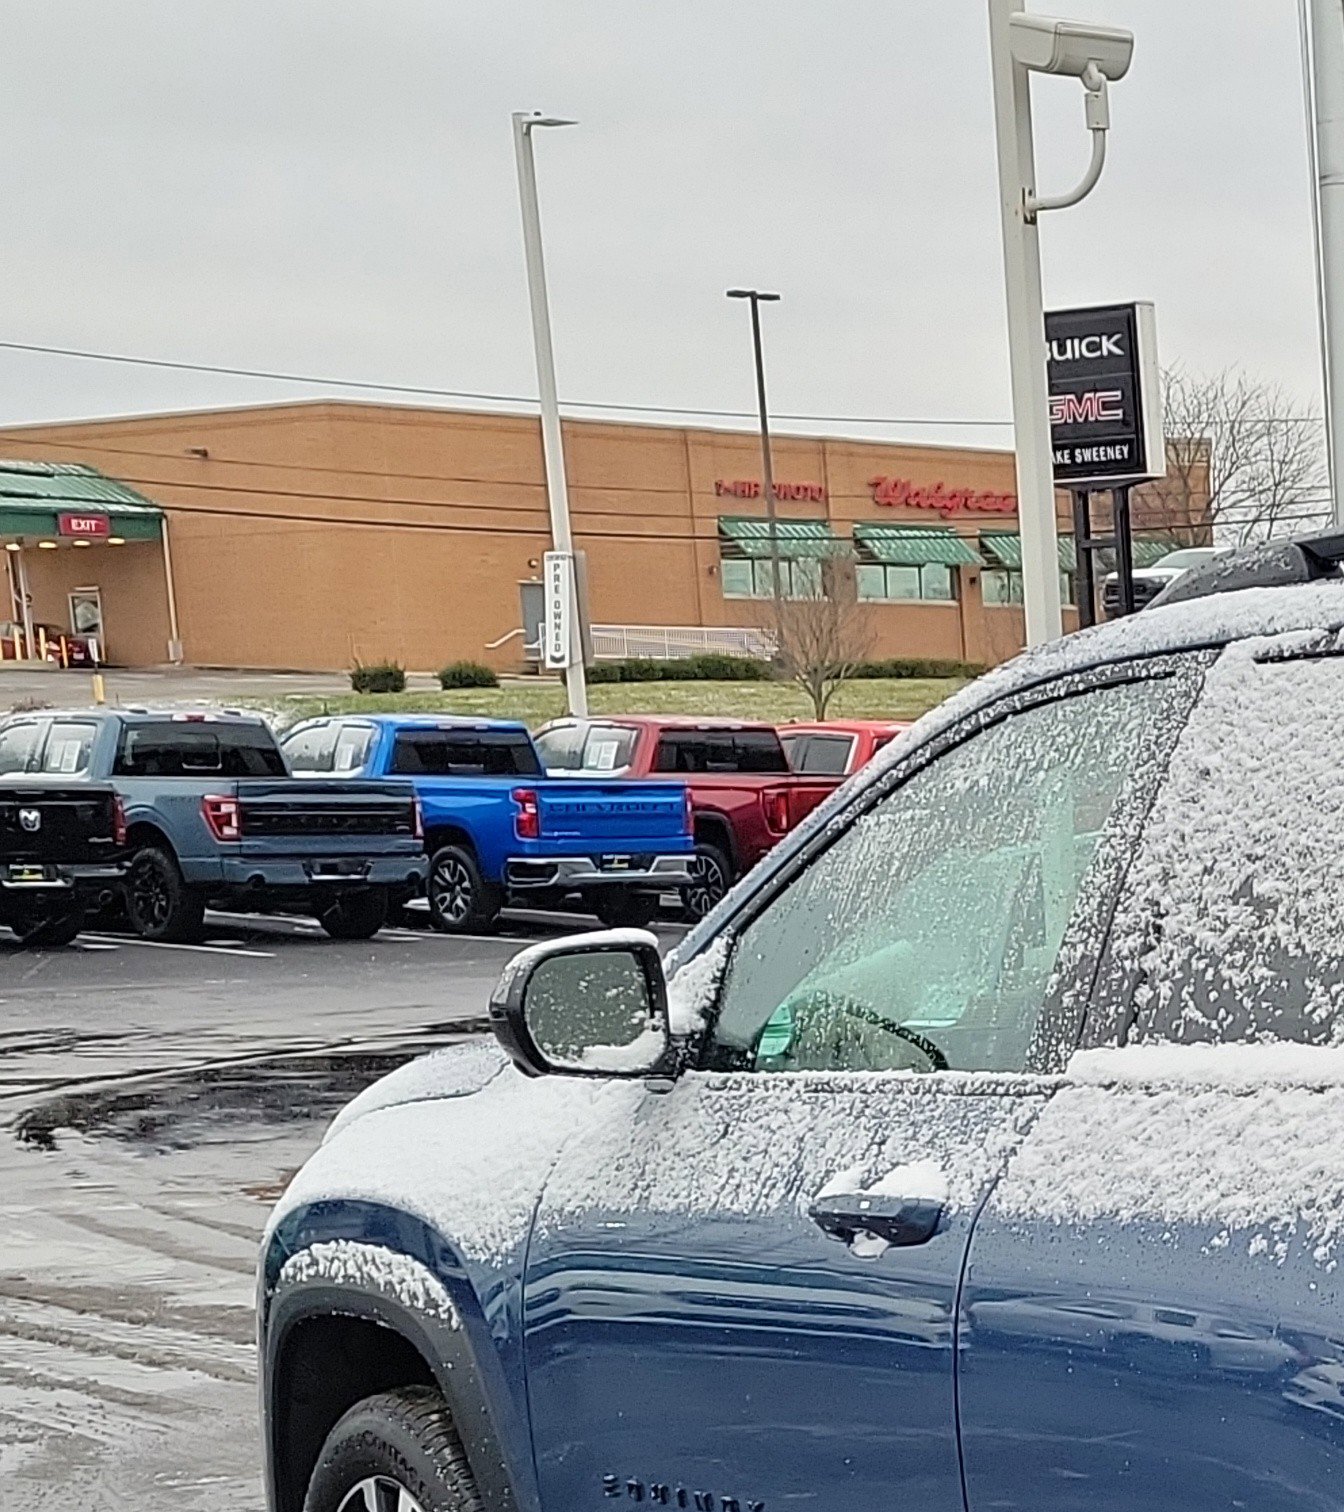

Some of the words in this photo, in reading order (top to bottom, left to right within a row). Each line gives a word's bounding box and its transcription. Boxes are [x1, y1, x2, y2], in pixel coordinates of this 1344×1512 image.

[1048, 390, 1123, 424] GMC
[1051, 448, 1071, 464] AKE
[1074, 444, 1129, 463] SWEENEY
[71, 518, 96, 531] EXIT
[553, 600, 561, 652] OWNED
